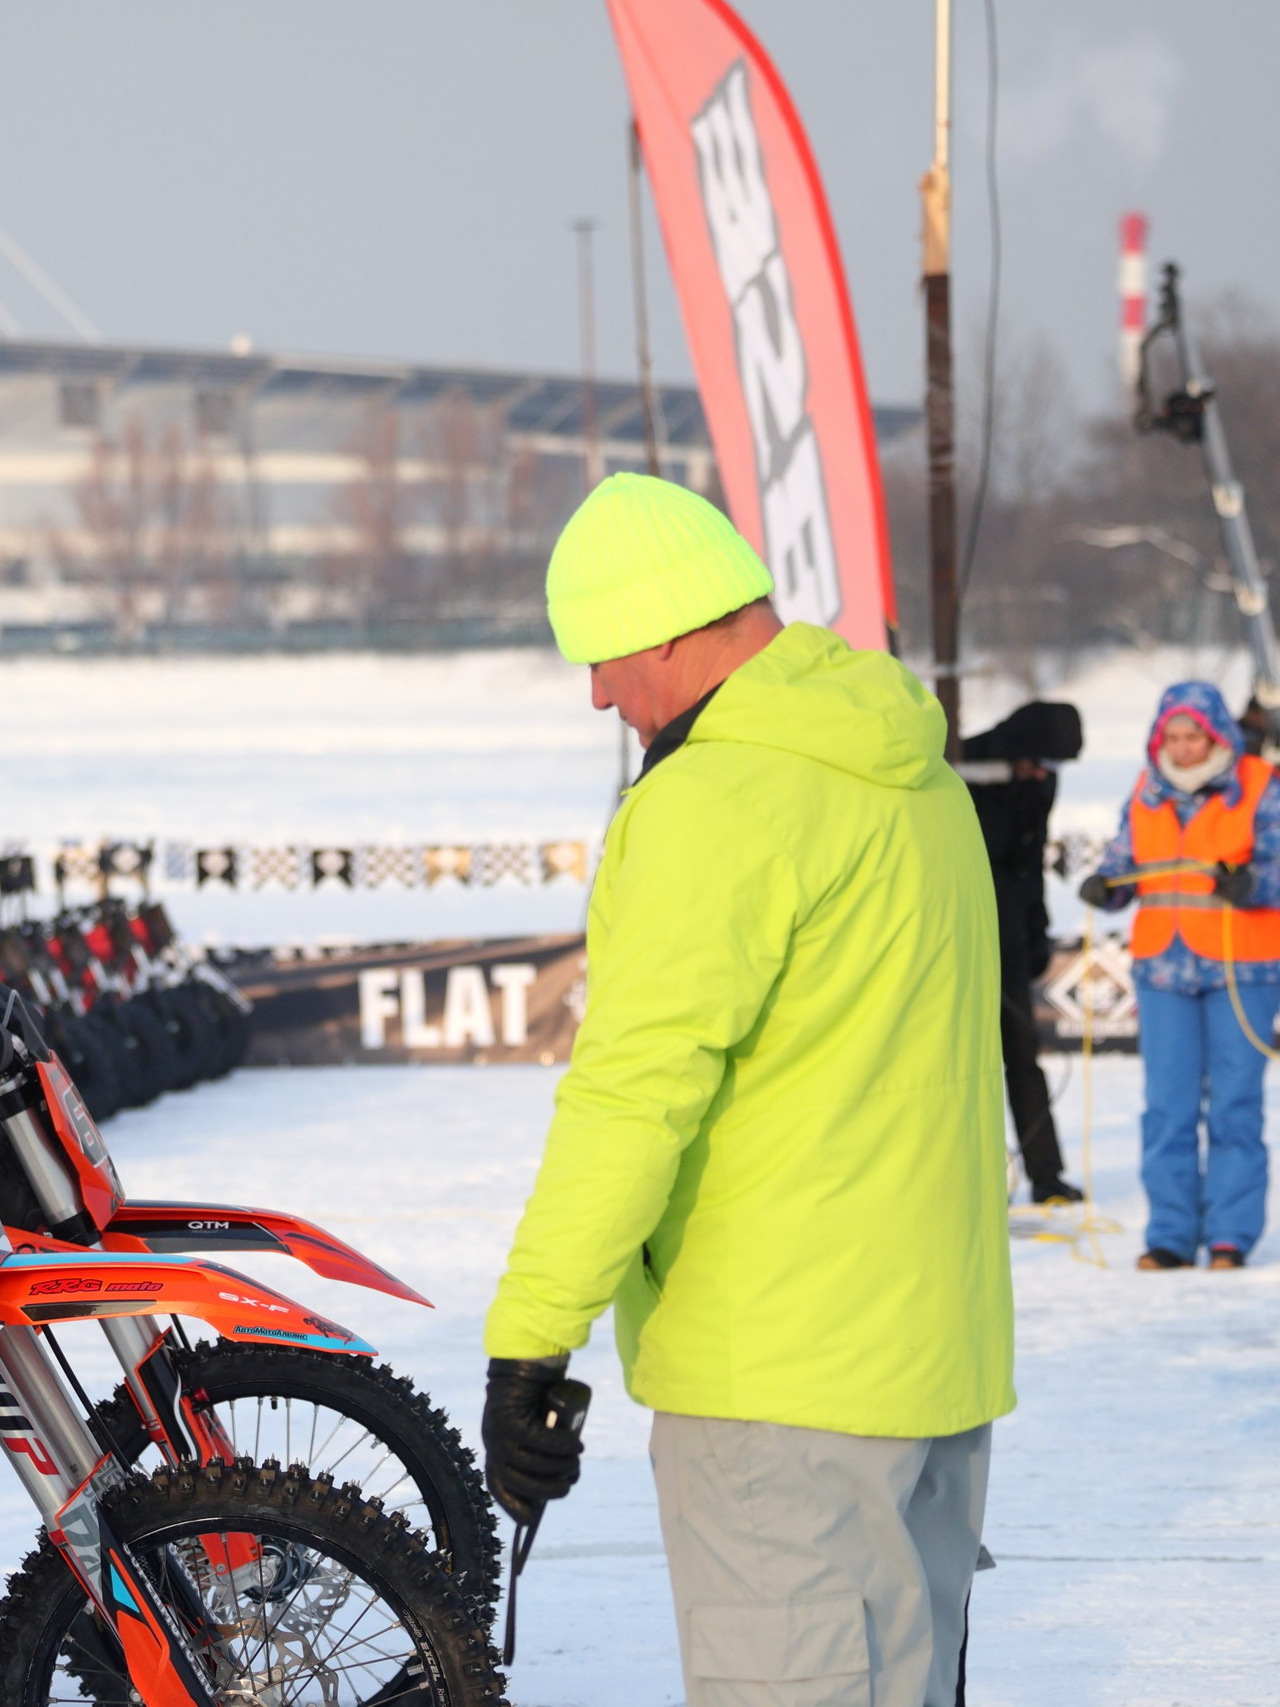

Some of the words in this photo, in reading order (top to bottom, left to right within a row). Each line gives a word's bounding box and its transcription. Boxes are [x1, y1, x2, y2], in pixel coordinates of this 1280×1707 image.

[358, 963, 538, 1049] FLAT
[187, 1220, 230, 1231] QTM
[28, 1278, 104, 1296] RRG
[104, 1280, 164, 1293] moto
[218, 1291, 290, 1314] SX-F
[419, 1641, 439, 1683] EXCEL
